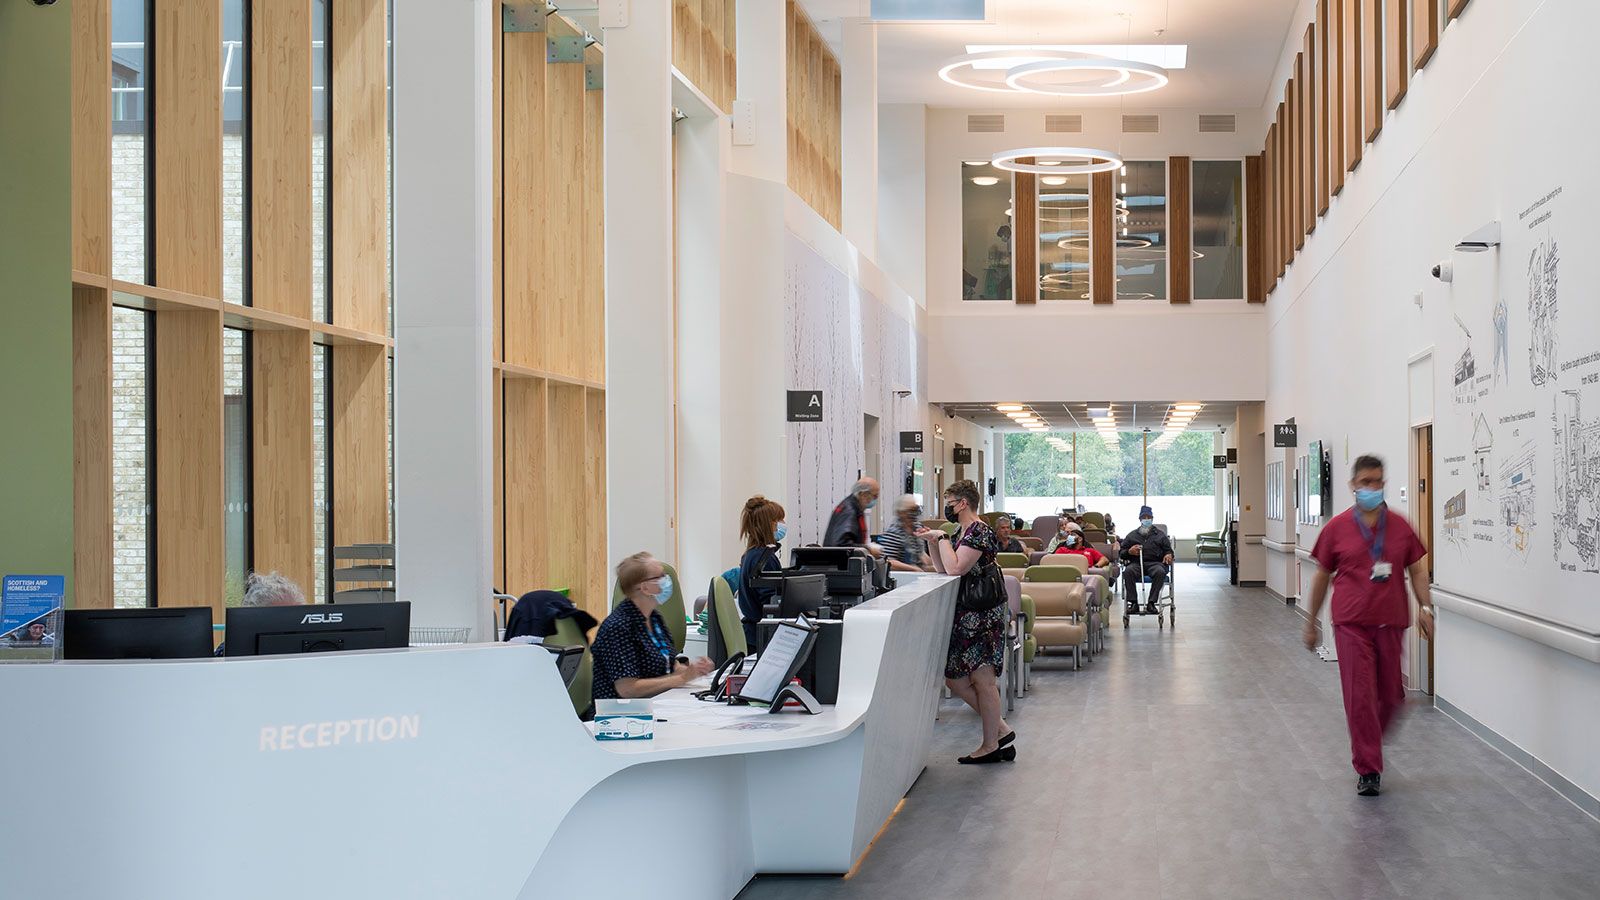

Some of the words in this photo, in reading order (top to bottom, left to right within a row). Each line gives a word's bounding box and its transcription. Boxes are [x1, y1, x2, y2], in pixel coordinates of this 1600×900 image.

[808, 394, 821, 407] A
[915, 433, 922, 443] B
[301, 613, 343, 624] ASUS
[259, 714, 420, 752] RECEPTION
